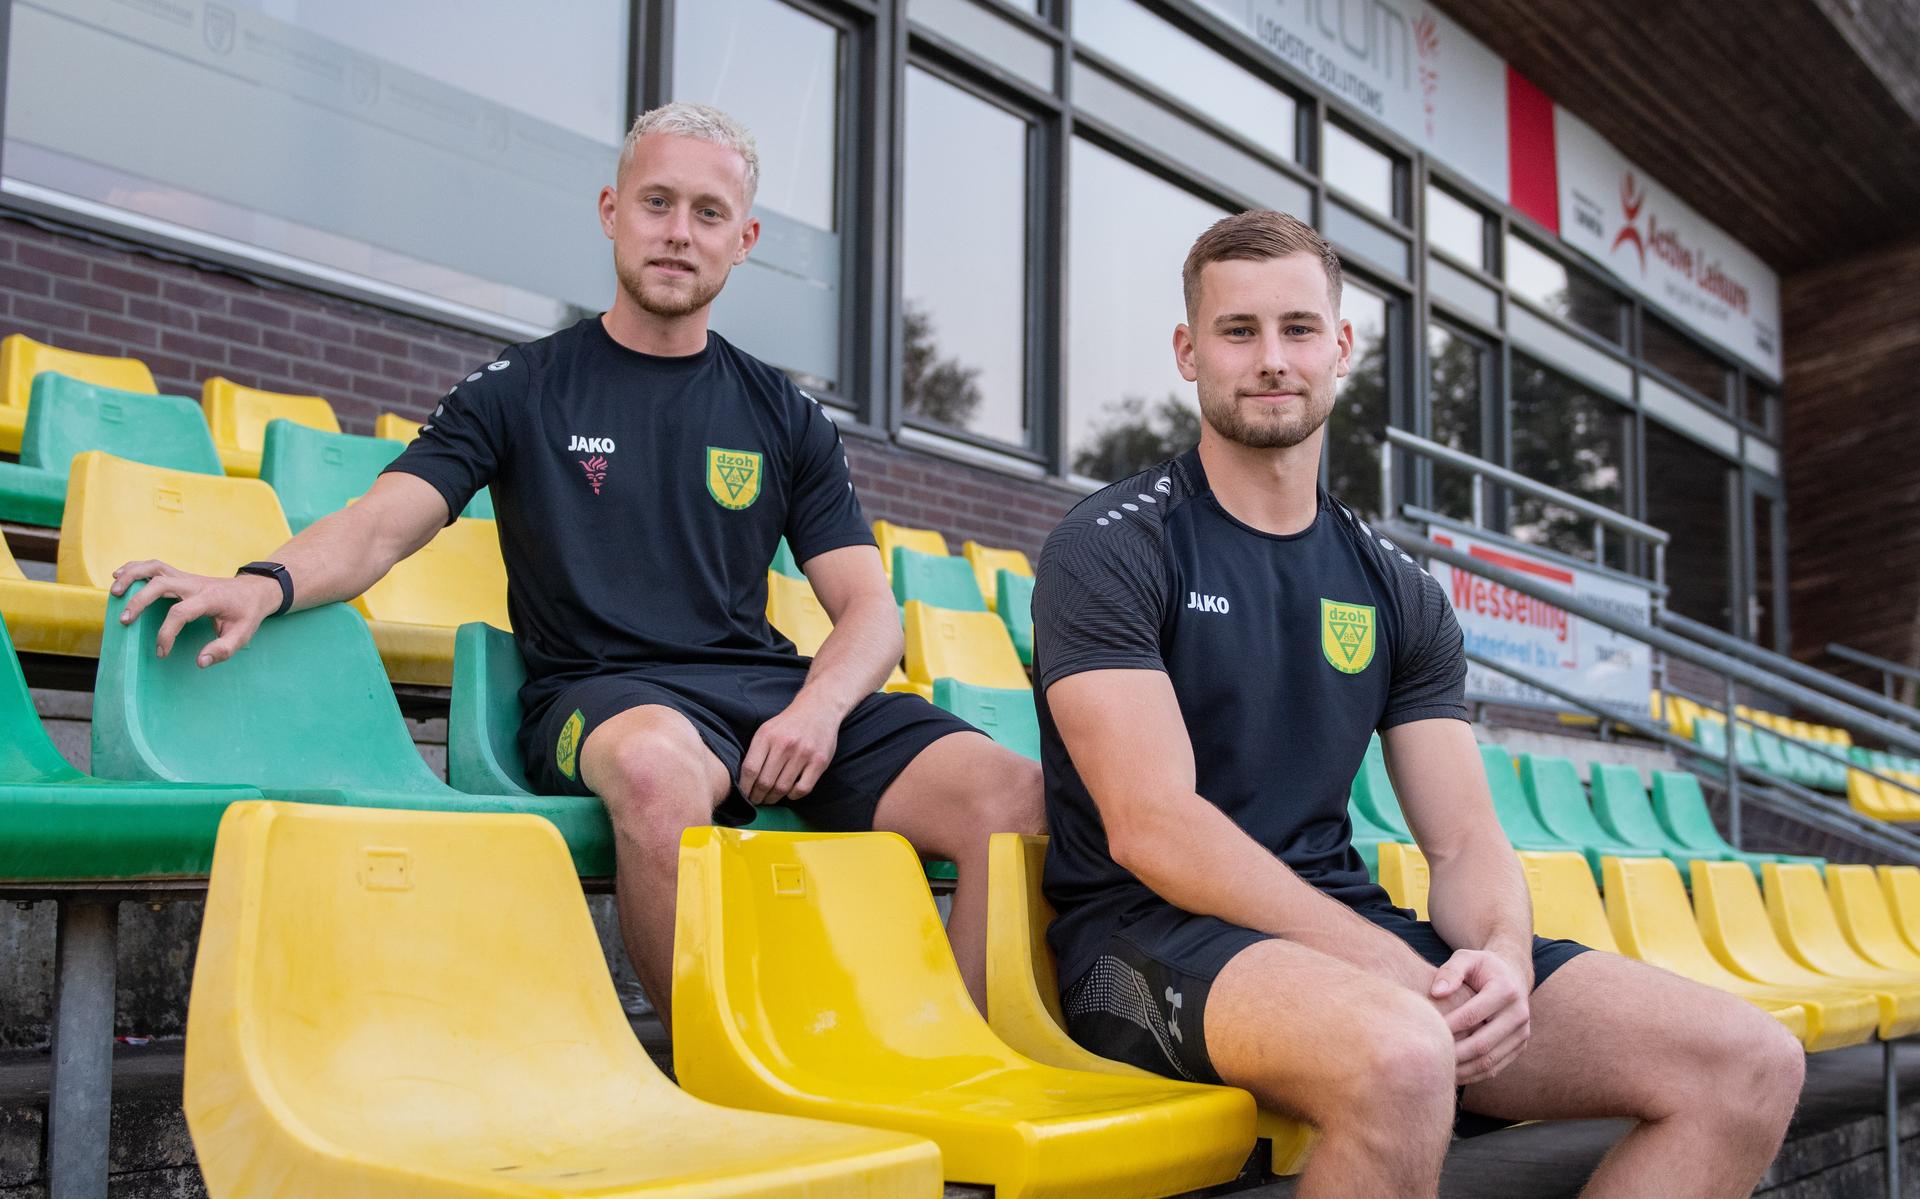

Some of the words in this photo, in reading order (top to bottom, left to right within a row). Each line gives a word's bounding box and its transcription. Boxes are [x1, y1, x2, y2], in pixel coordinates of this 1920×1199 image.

[1256, 14, 1314, 73] LOGISTIC
[1317, 54, 1384, 115] SOLUTIONS
[568, 435, 616, 454] JAKO
[717, 453, 754, 467] dzoh
[1187, 592, 1230, 614] JAKO
[1329, 607, 1367, 623] dzoh
